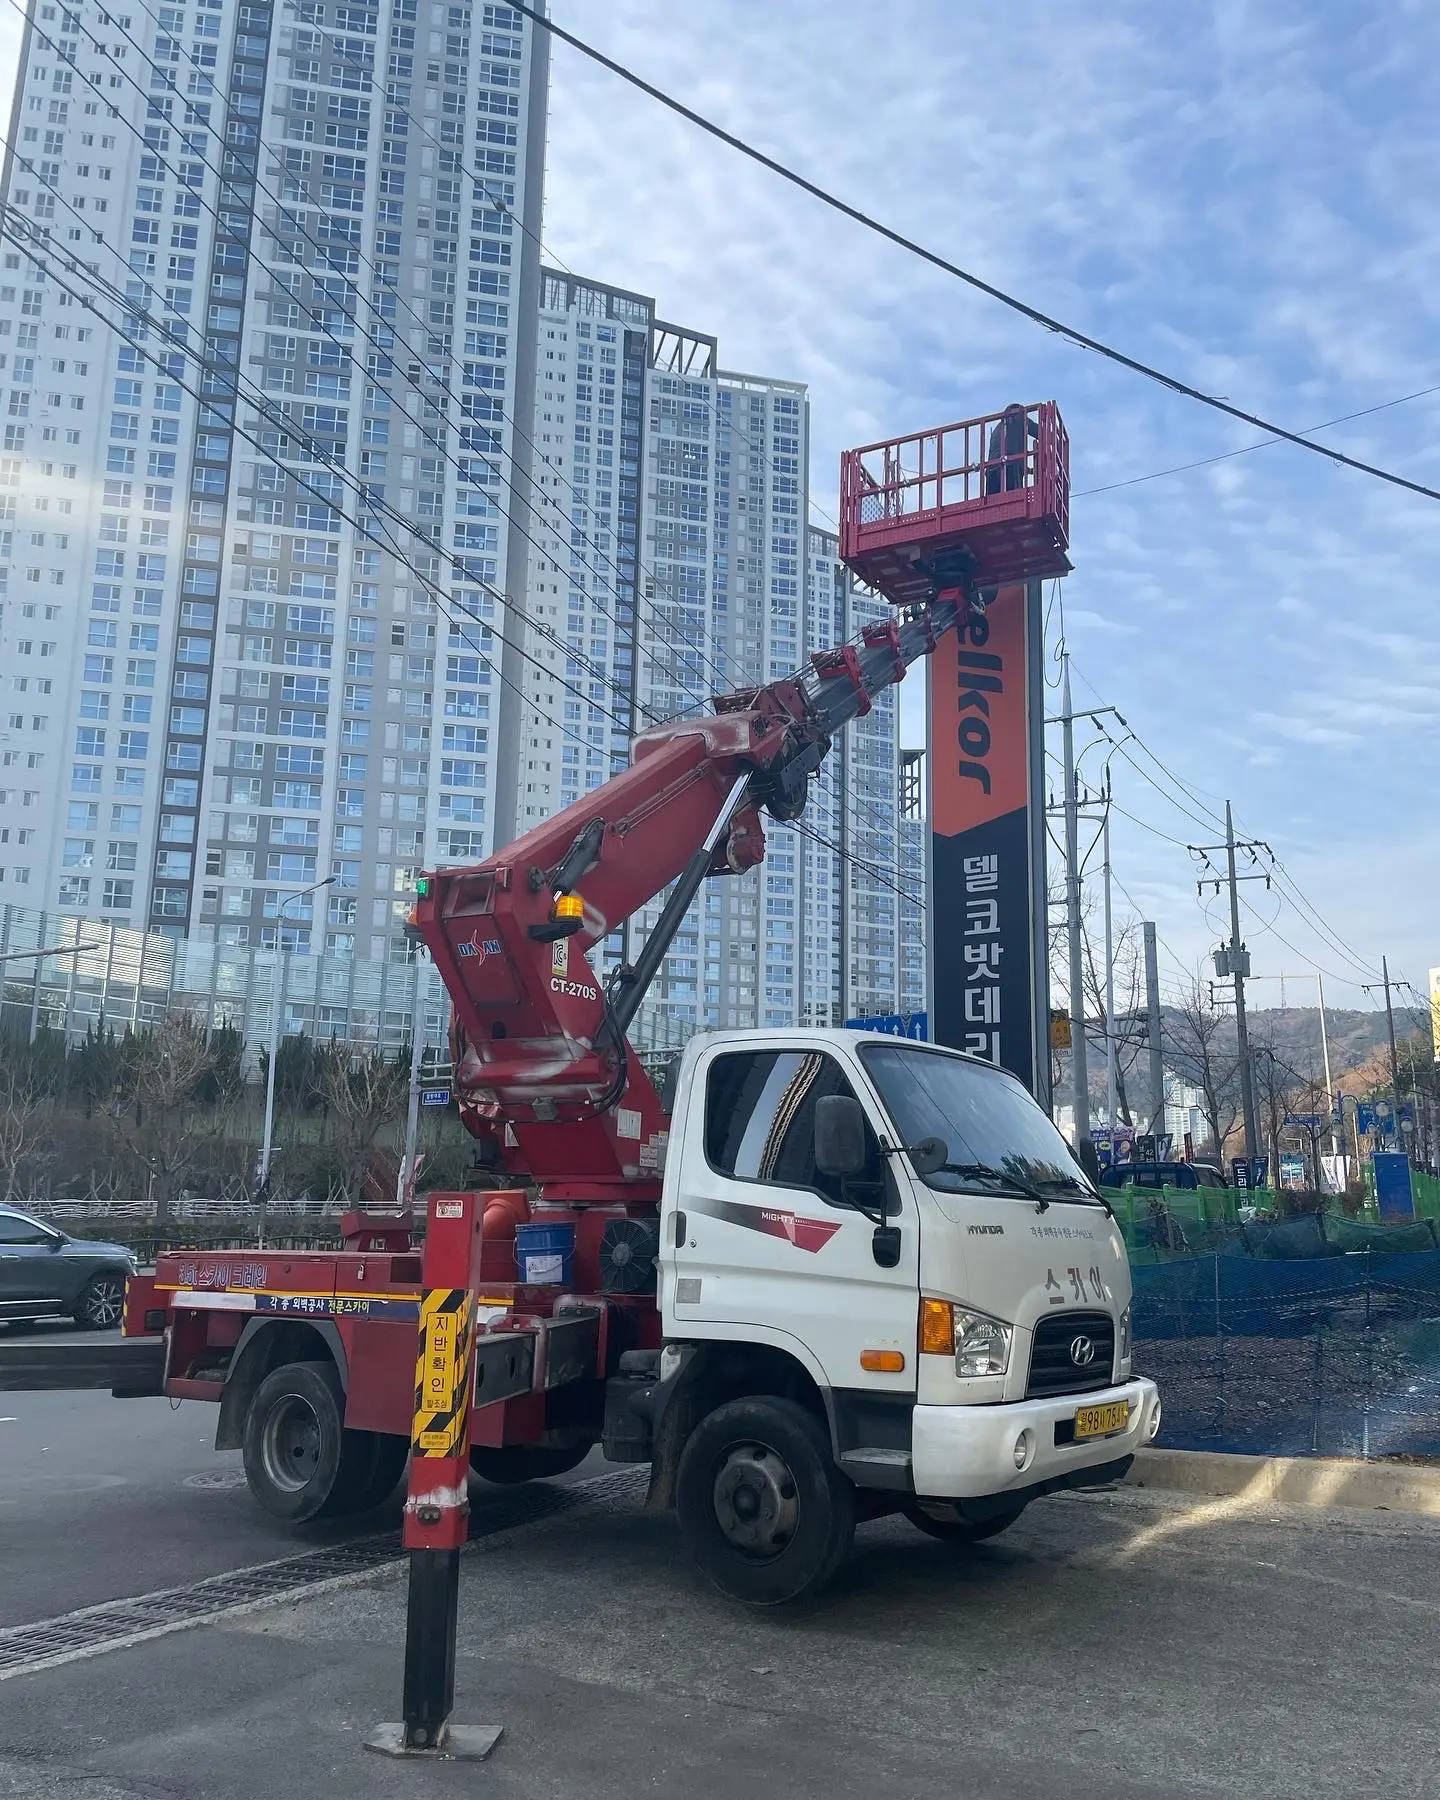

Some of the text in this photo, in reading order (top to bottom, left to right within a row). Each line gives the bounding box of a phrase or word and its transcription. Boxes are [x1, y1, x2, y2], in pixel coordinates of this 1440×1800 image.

[957, 586, 1003, 794] elkor
[457, 929, 501, 967] DASAN
[963, 853, 1004, 1066] 델코밧데리
[550, 977, 597, 1001] CT-270S
[761, 1211, 795, 1225] MIGHTY
[967, 1224, 1004, 1235] HYUNDAI
[1045, 1265, 1107, 1305] 스카이
[292, 1297, 325, 1313] 외벽공사
[431, 1316, 449, 1393] 지반확인
